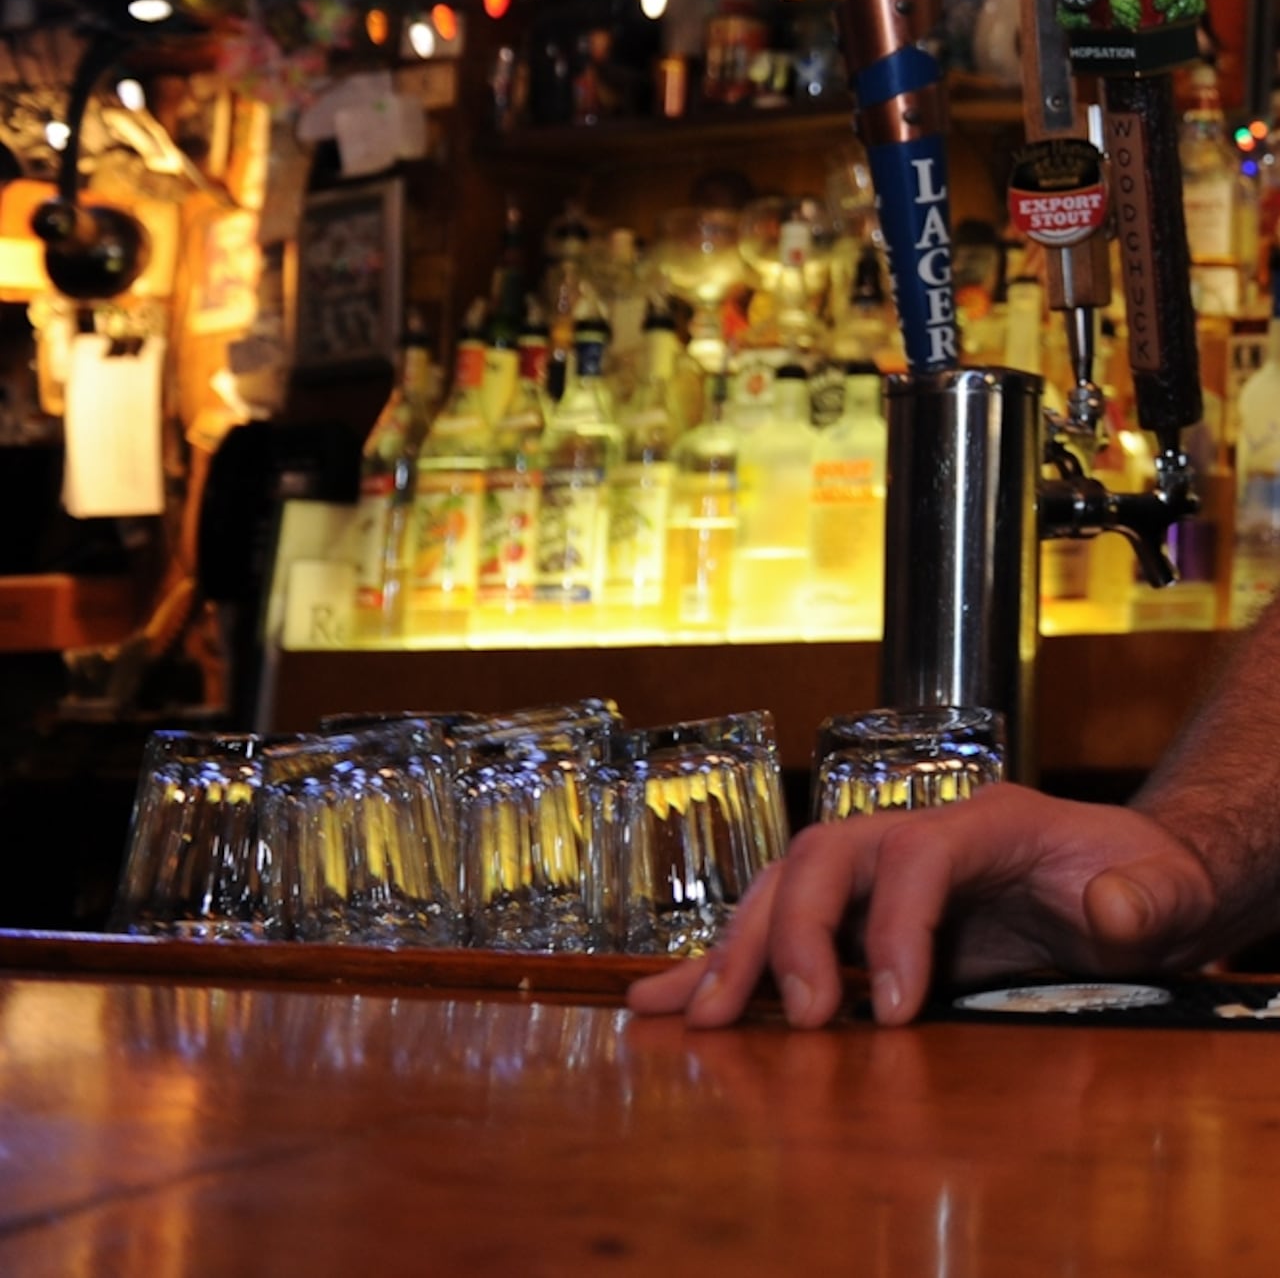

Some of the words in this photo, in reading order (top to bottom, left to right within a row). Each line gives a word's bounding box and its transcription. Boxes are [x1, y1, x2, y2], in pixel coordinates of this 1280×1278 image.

[1069, 45, 1137, 61] HOPSATION
[1018, 193, 1102, 216] EXPORT
[1029, 209, 1093, 229] STOUT
[1113, 121, 1151, 362] WOODCHUCK
[911, 157, 958, 364] LAGER
